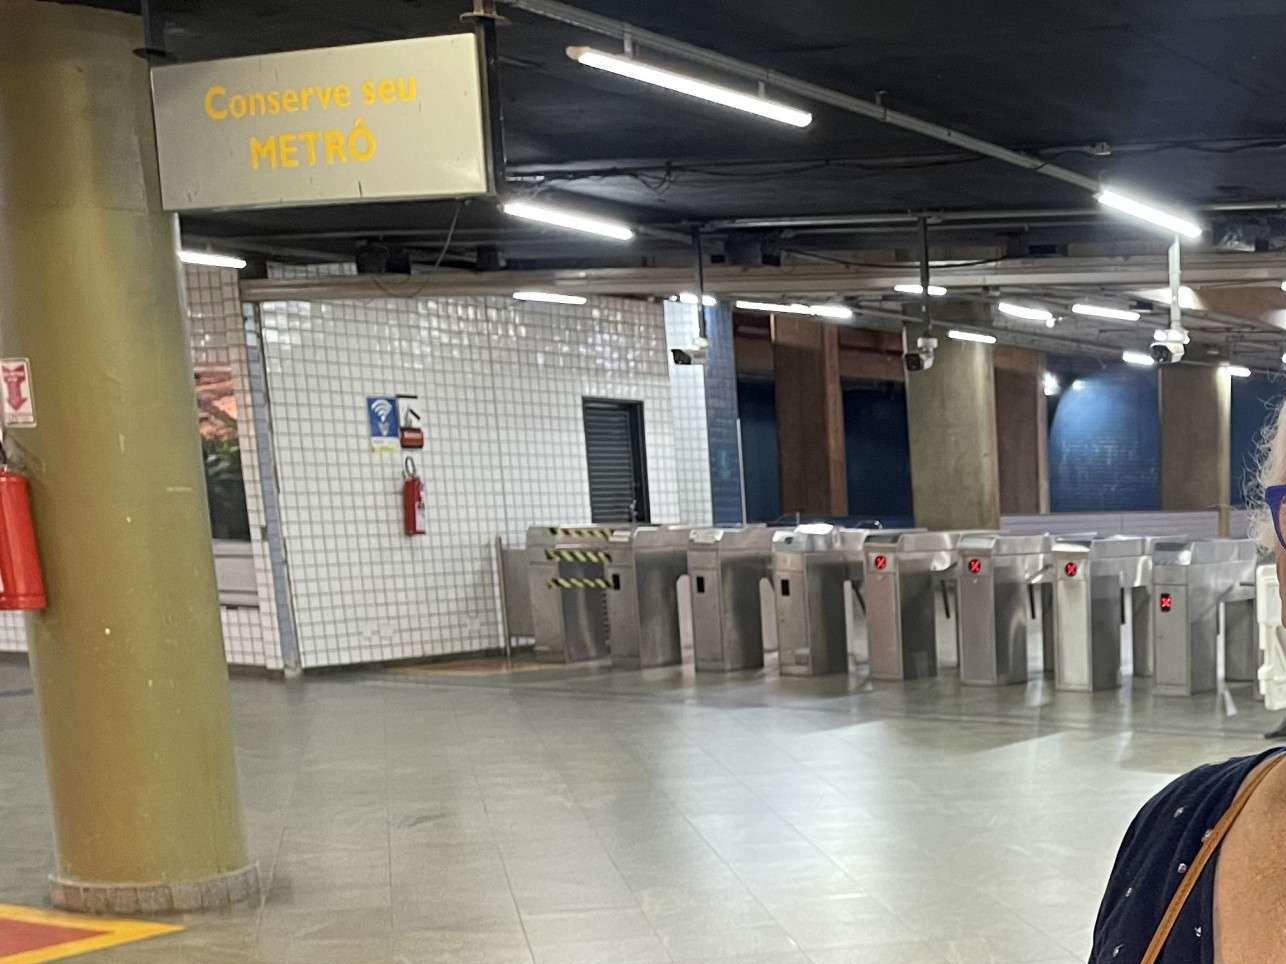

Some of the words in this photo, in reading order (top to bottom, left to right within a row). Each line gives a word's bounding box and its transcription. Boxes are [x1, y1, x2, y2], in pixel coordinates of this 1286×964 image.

[204, 82, 351, 121] Conserve
[361, 74, 417, 105] seu
[249, 116, 378, 171] METRÔ
